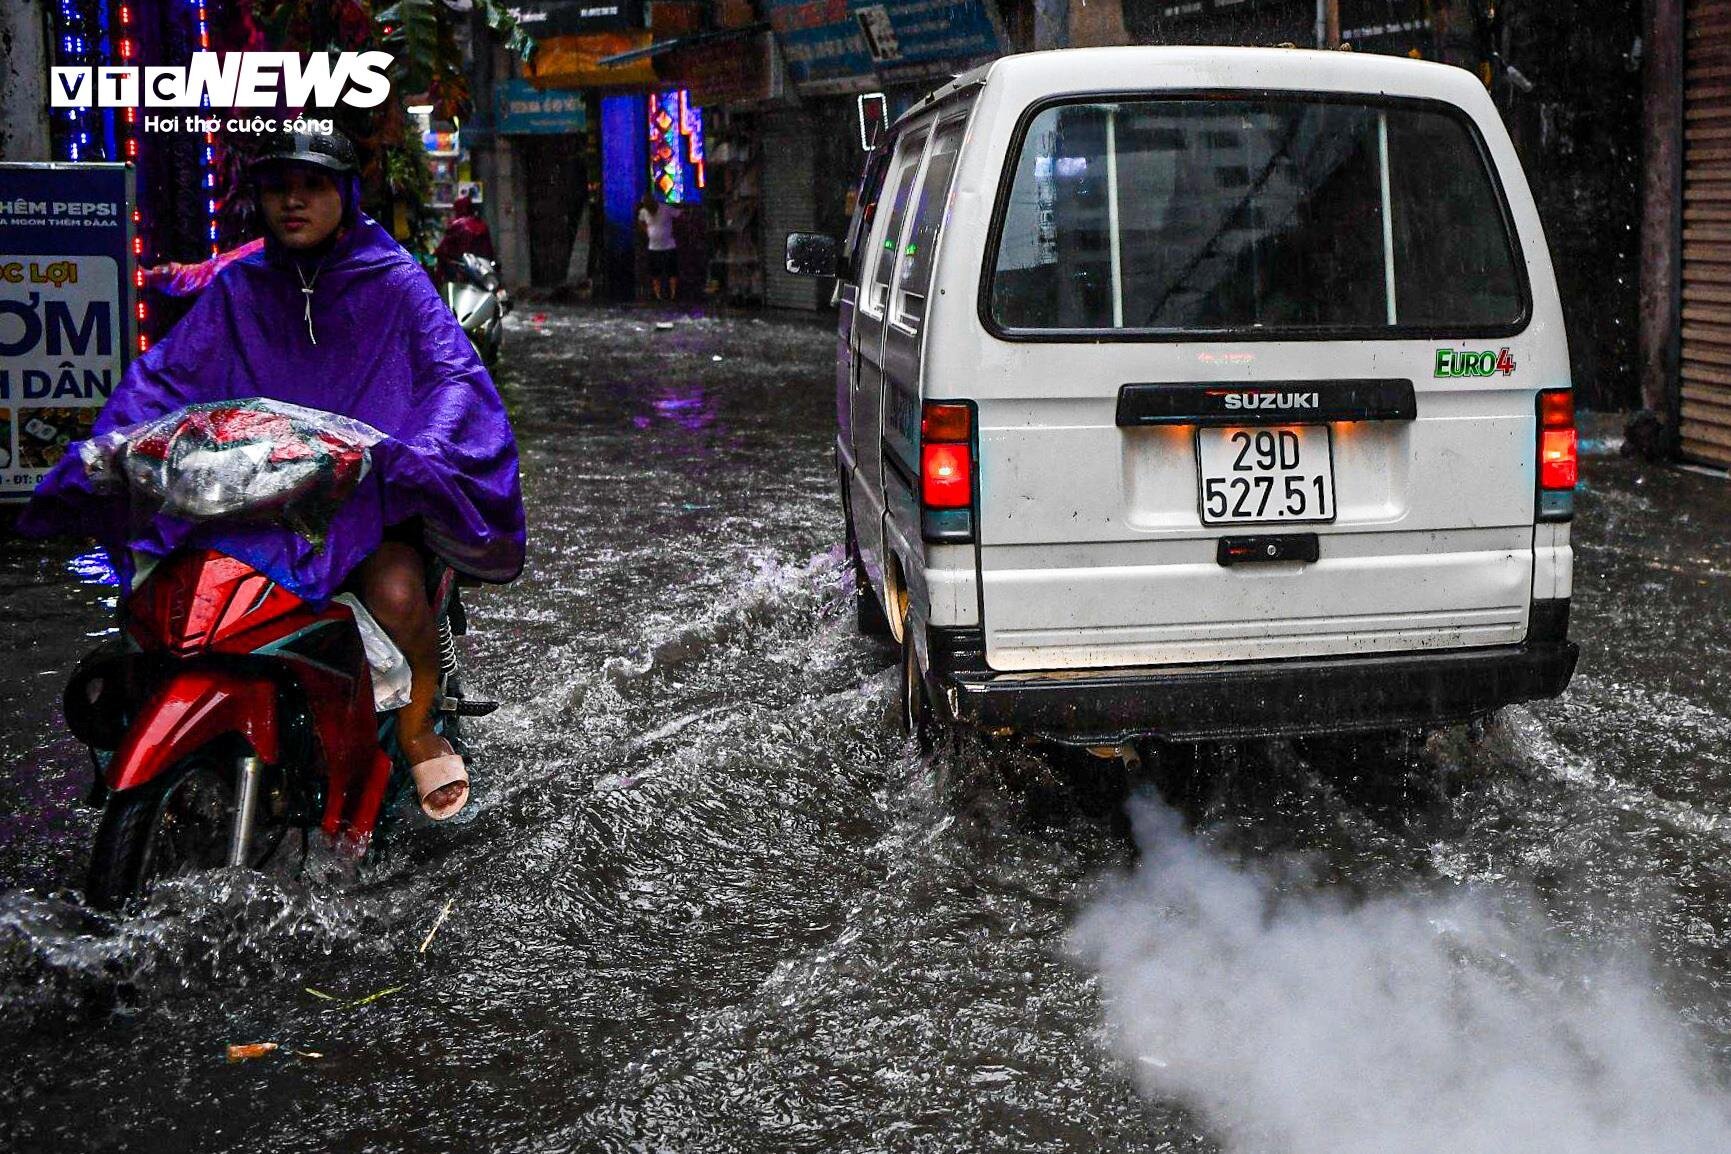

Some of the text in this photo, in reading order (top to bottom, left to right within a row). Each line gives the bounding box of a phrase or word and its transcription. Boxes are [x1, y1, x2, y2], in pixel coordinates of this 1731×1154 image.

[53, 202, 117, 216] PEPSI
[29, 261, 78, 288] LỢI
[22, 361, 112, 399] DÂN
[1224, 393, 1319, 409] SUZUKI
[1231, 430, 1300, 471] 29D
[1206, 475, 1325, 518] 527.51
